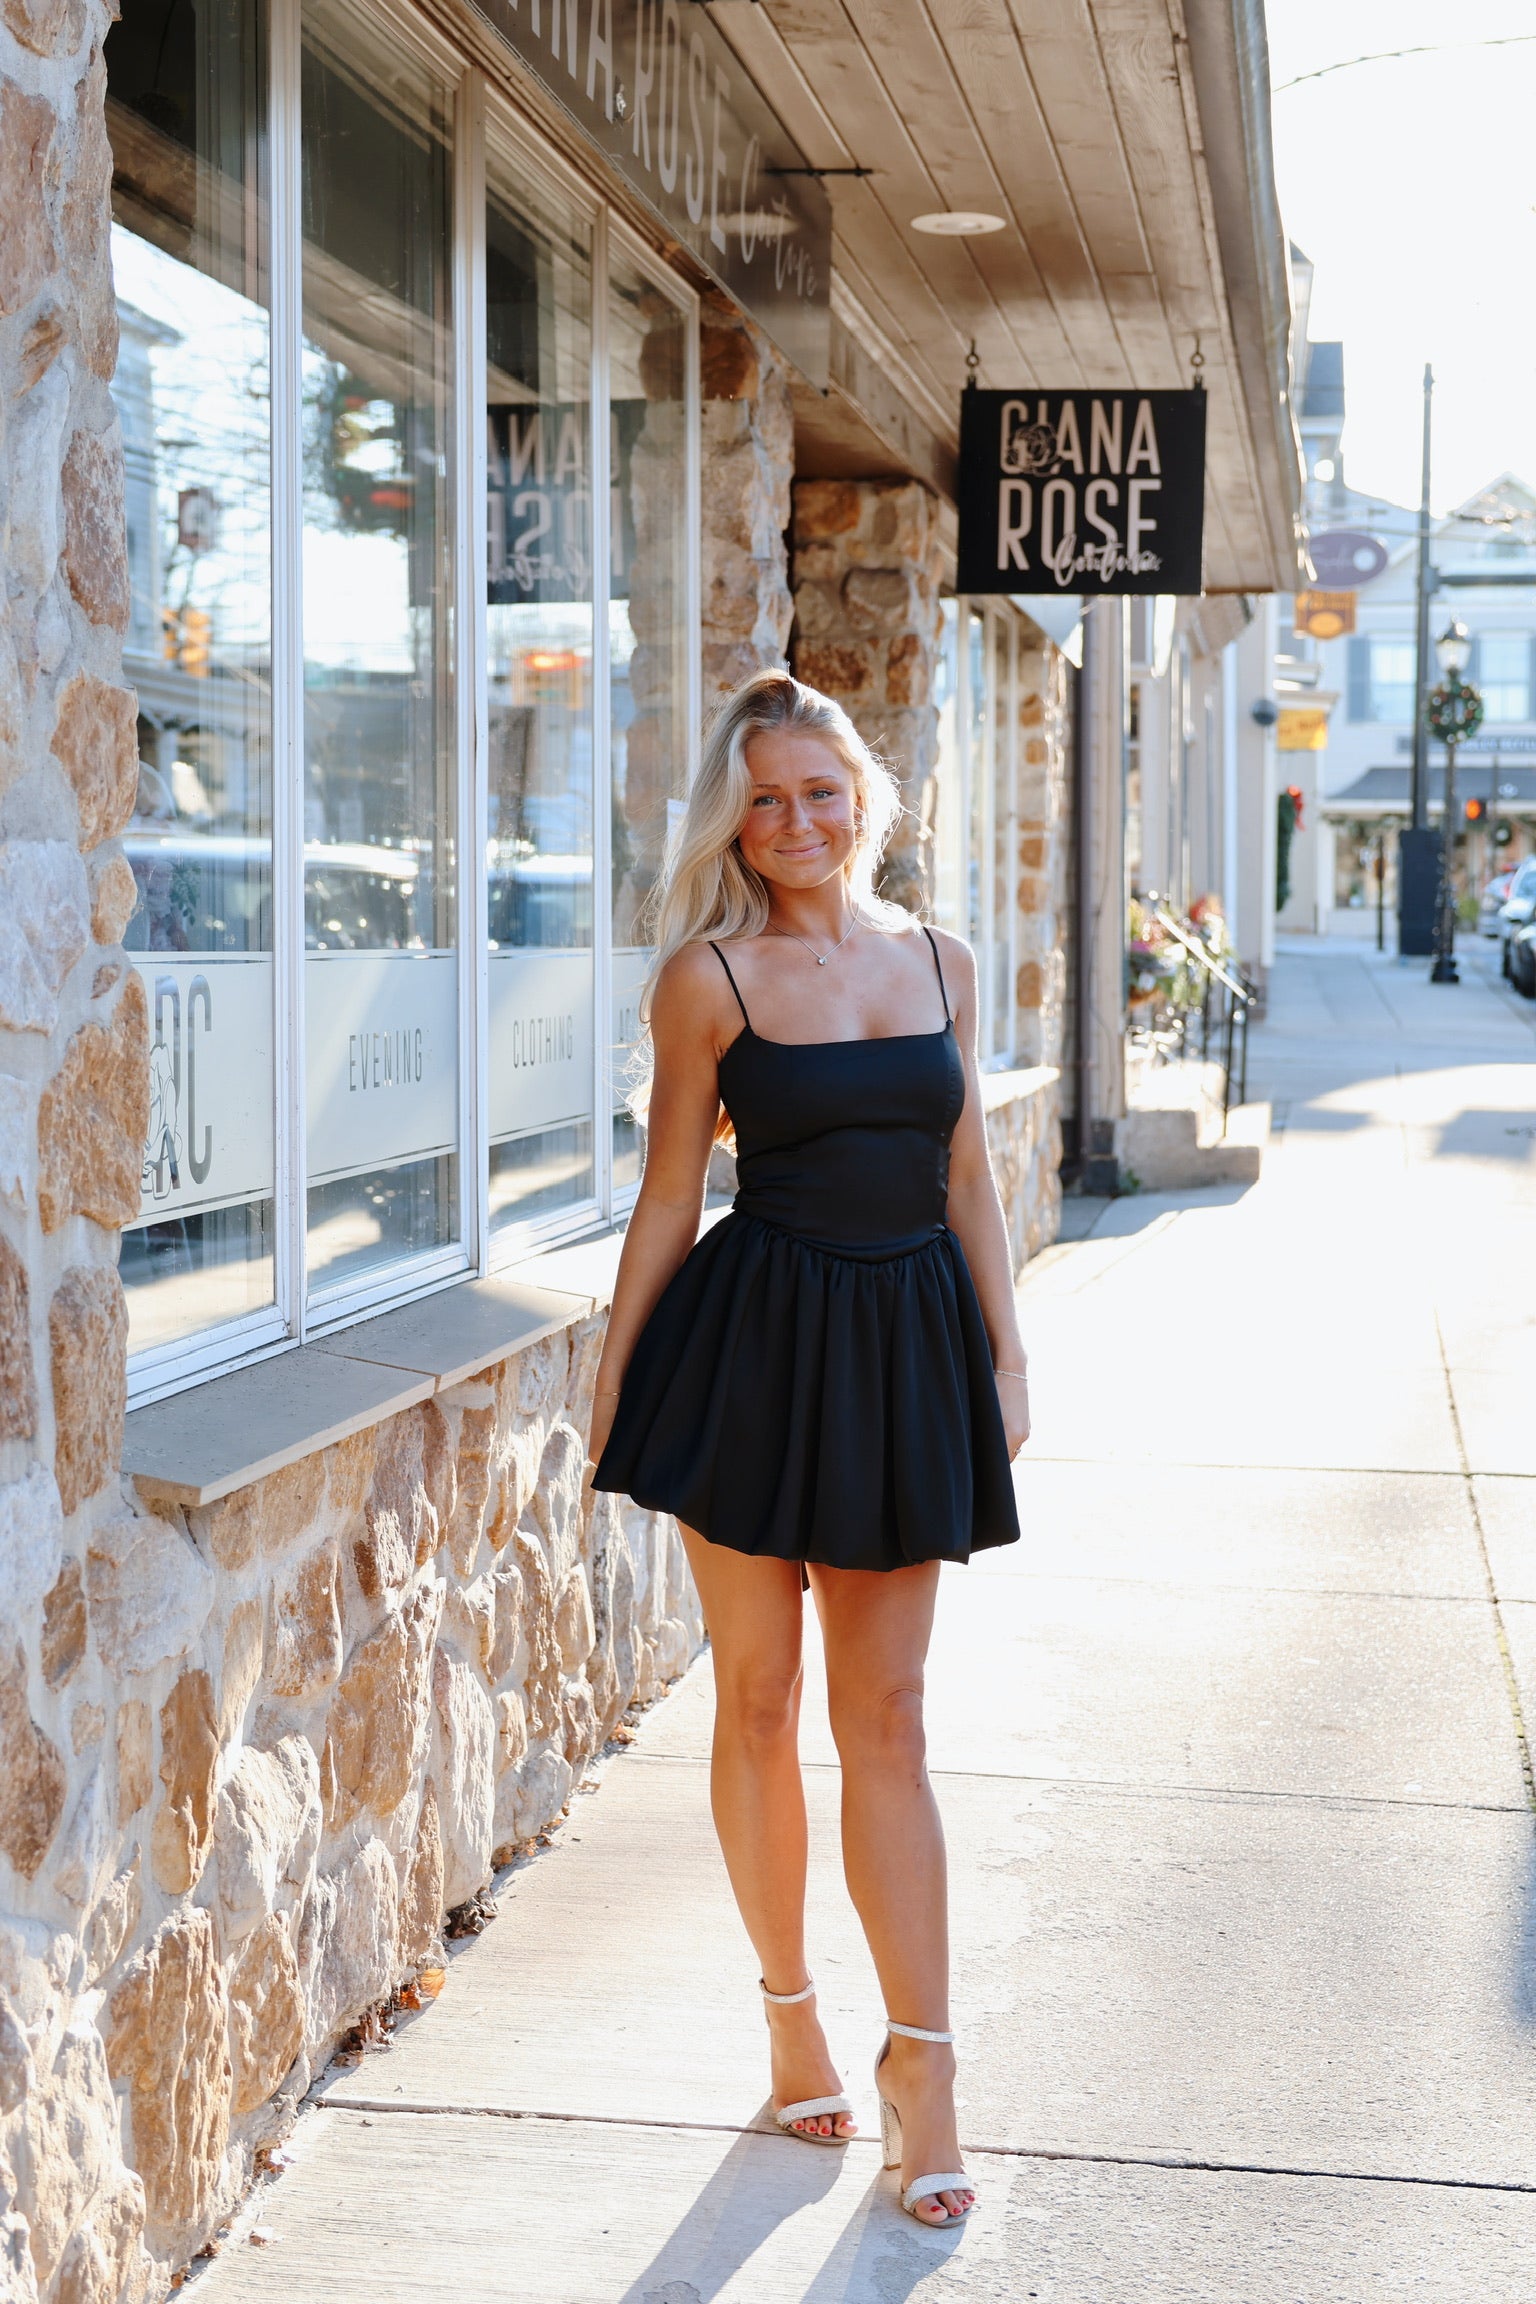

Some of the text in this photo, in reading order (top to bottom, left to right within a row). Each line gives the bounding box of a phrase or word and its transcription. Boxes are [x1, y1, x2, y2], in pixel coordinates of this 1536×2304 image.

[630, 0, 731, 256] ROSE
[997, 478, 1162, 571] ROSE
[349, 1027, 422, 1092] EVENING
[513, 1015, 573, 1069] CLOTHING
